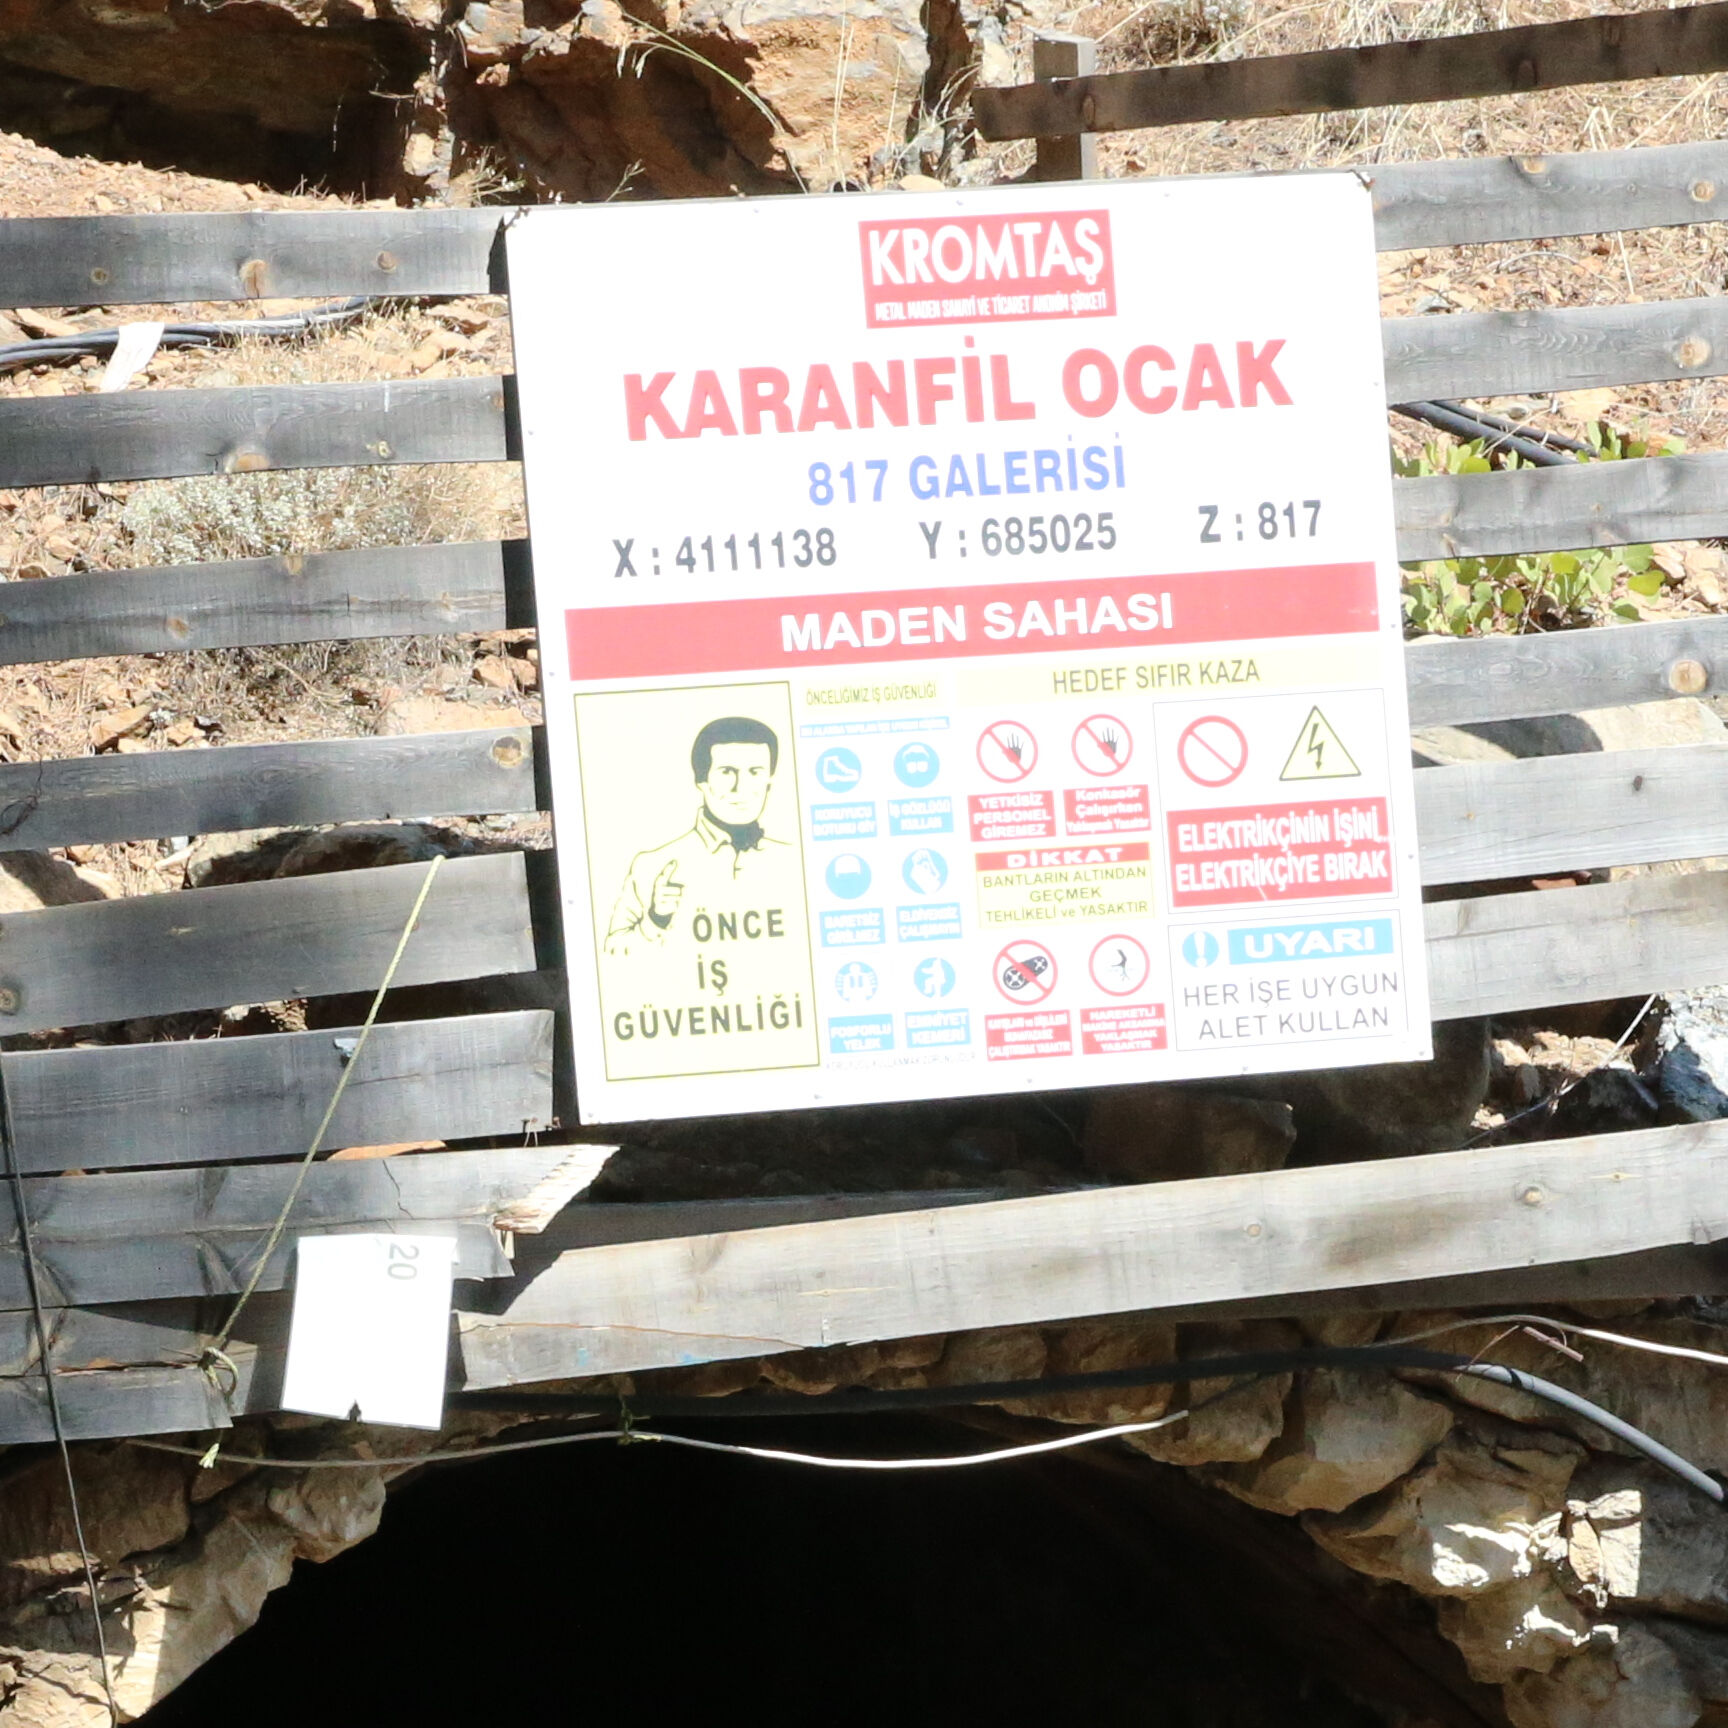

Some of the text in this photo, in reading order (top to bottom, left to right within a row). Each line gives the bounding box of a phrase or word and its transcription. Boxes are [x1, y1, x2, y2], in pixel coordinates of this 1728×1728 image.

[869, 218, 1104, 285] KROMTAŞ
[977, 297, 991, 315] VE
[623, 335, 1295, 442] KARANFİL OCAK
[807, 432, 1126, 507] 817 GALERİSİ
[674, 526, 838, 574] 4111138
[980, 511, 1118, 557] 685025
[1257, 499, 1323, 541] 817
[780, 592, 1173, 652] MADEN SAHASI
[883, 679, 937, 701] GÜVENLİĞİ
[1052, 658, 1260, 695] HEDEF SIFIR KAZA
[973, 809, 1051, 825] PERSONEL
[979, 793, 1043, 809] YETKİSİZ
[980, 823, 1046, 839] GİREMEZ
[1177, 812, 1330, 852] ELEKTRİKÇİNİN
[1006, 847, 1123, 868] DİKKAT
[1175, 850, 1388, 892] ELEKTRİKÇİYE BIRAK
[982, 866, 1147, 889] BANTLARIN ALTINDAN
[1029, 886, 1103, 904] GEÇMEK
[691, 906, 785, 943] ÖNCE
[985, 900, 1149, 923] TEHLİKELİ ve YASAKTIR
[1243, 926, 1375, 959] UYARI
[696, 953, 729, 996] İŞ
[1183, 971, 1399, 1008] HER İŞE UYGUN
[613, 992, 803, 1041] GÜVENLİĞİ
[1198, 1005, 1389, 1040] ALET KULLAN
[386, 1241, 421, 1281] 20
